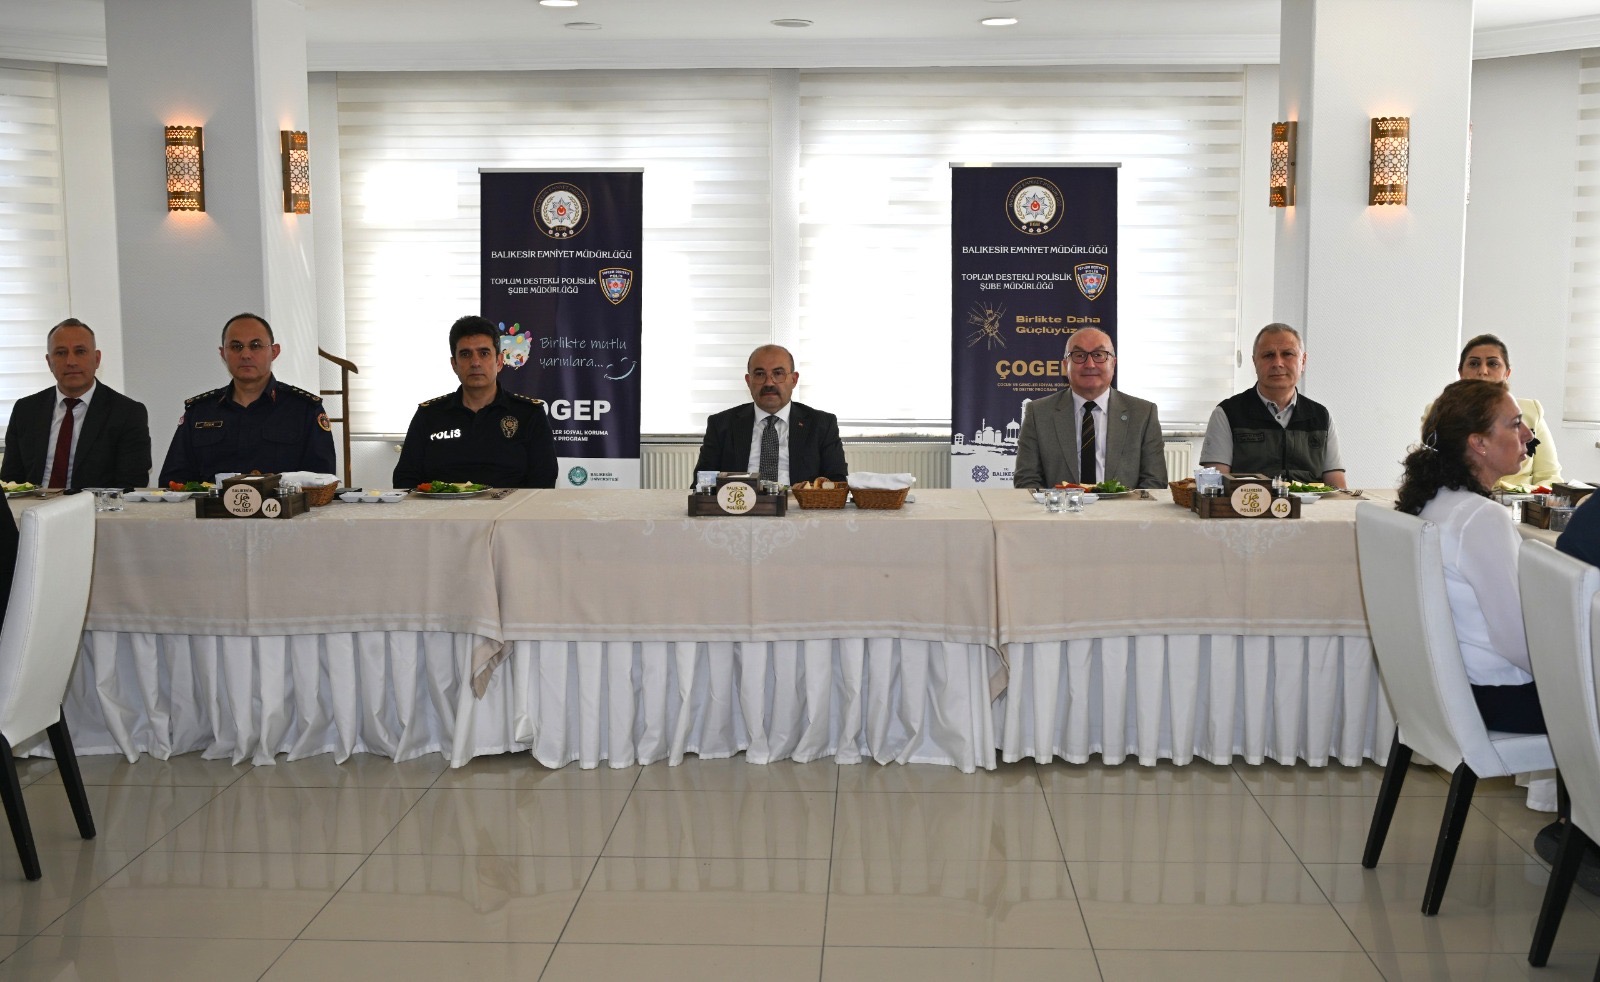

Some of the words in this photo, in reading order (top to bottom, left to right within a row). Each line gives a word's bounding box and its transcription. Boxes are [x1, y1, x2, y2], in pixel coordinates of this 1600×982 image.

[491, 250, 536, 259] BALIKESİR
[537, 250, 574, 259] EMNİYET
[575, 249, 632, 259] MÜDÜRLÜĞÜ
[962, 245, 1009, 254] BALIKESİR
[1010, 245, 1049, 254] EMNİYET
[1050, 245, 1108, 254] MÜDÜRLÜĞÜ
[523, 277, 560, 285] DESTEKLİ
[561, 276, 597, 285] POLİSLİK
[995, 273, 1035, 281] DESTEKLİ
[1036, 272, 1072, 281] POLİSLİK
[507, 287, 528, 295] ŞUBE
[529, 286, 579, 294] MÜDÜRLÜĞÜ
[979, 283, 1001, 291] ŞUBE
[1003, 281, 1053, 290] MÜDÜRLÜĞÜ
[1015, 315, 1062, 323] Birlikte
[539, 337, 586, 349] Birlikte
[591, 337, 627, 350] mutlu
[542, 399, 611, 421] GEP
[265, 503, 278, 512] 44
[1274, 503, 1288, 513] 43
